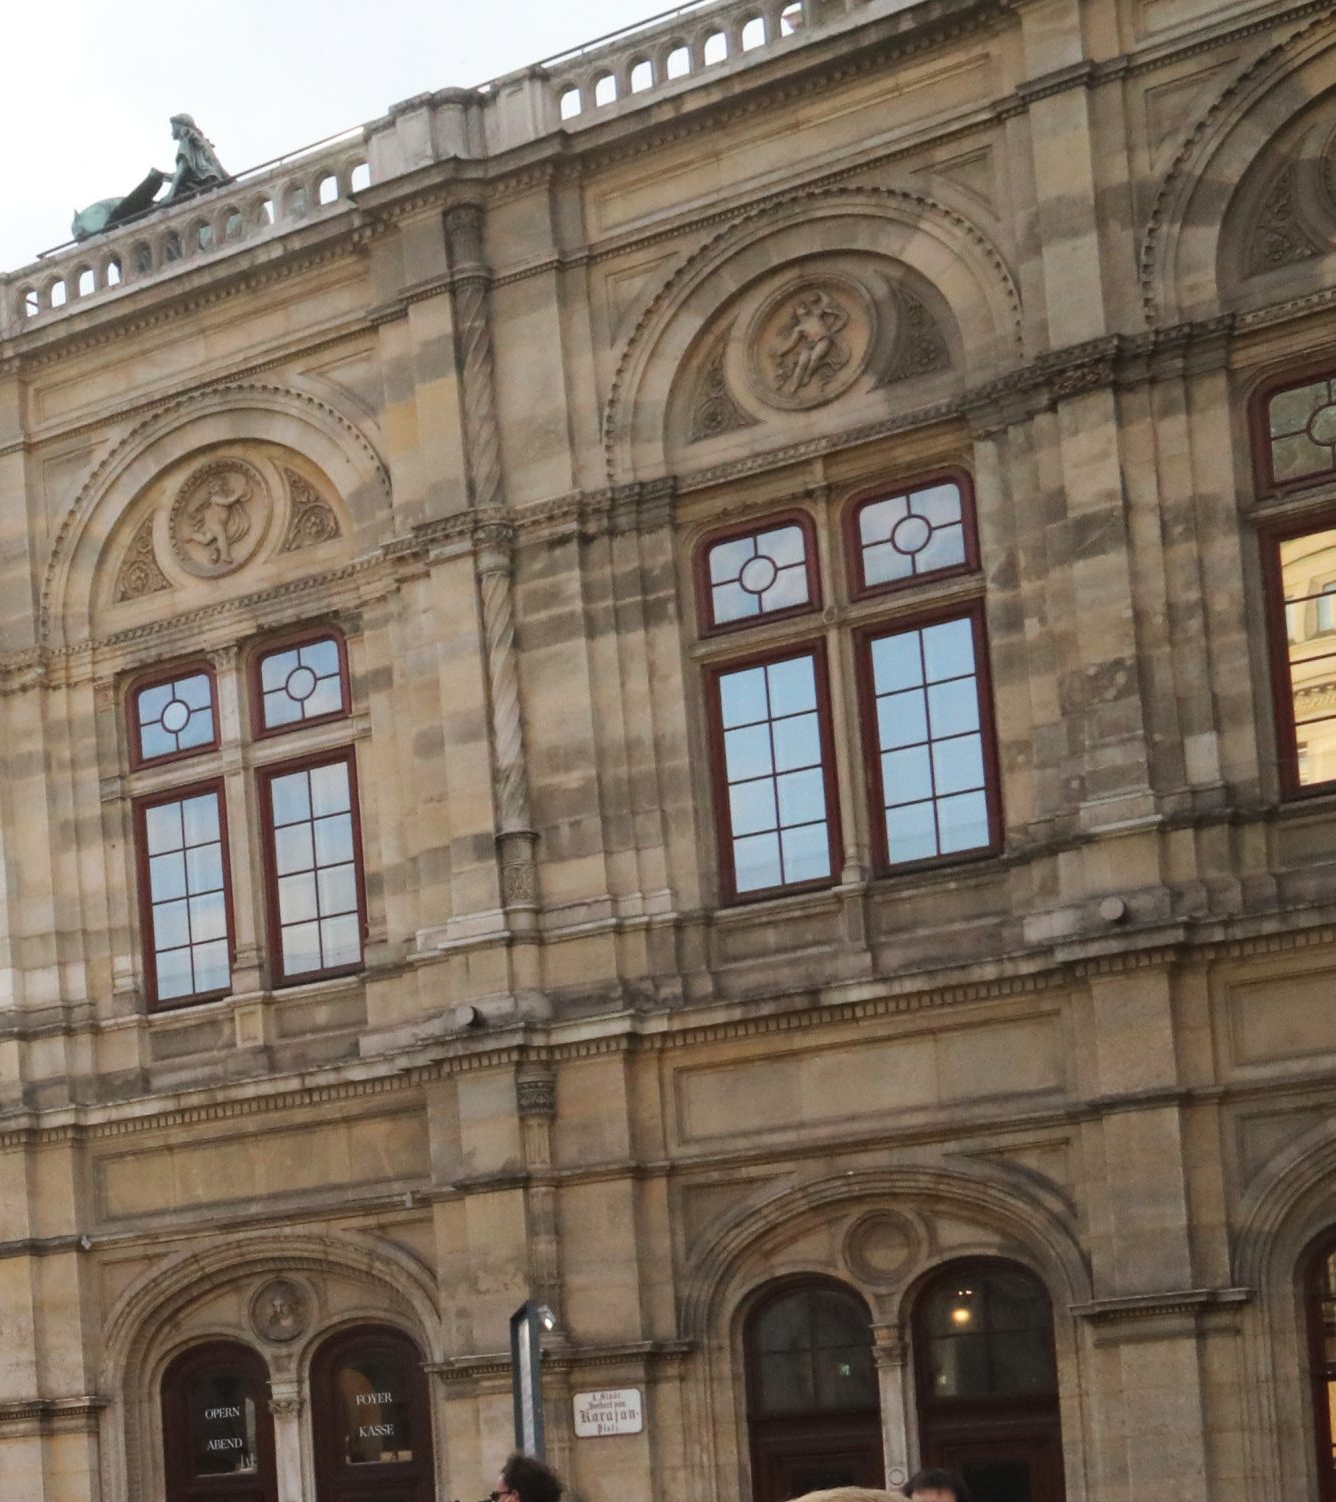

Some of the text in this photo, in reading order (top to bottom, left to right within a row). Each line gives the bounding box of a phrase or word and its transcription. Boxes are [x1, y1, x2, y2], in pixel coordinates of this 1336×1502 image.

[356, 1392, 393, 1405] FOYER
[205, 1406, 240, 1420] OPERN
[579, 1409, 639, 1423] Karajan-
[359, 1423, 394, 1438] KASSE
[207, 1438, 243, 1451] ABEND
